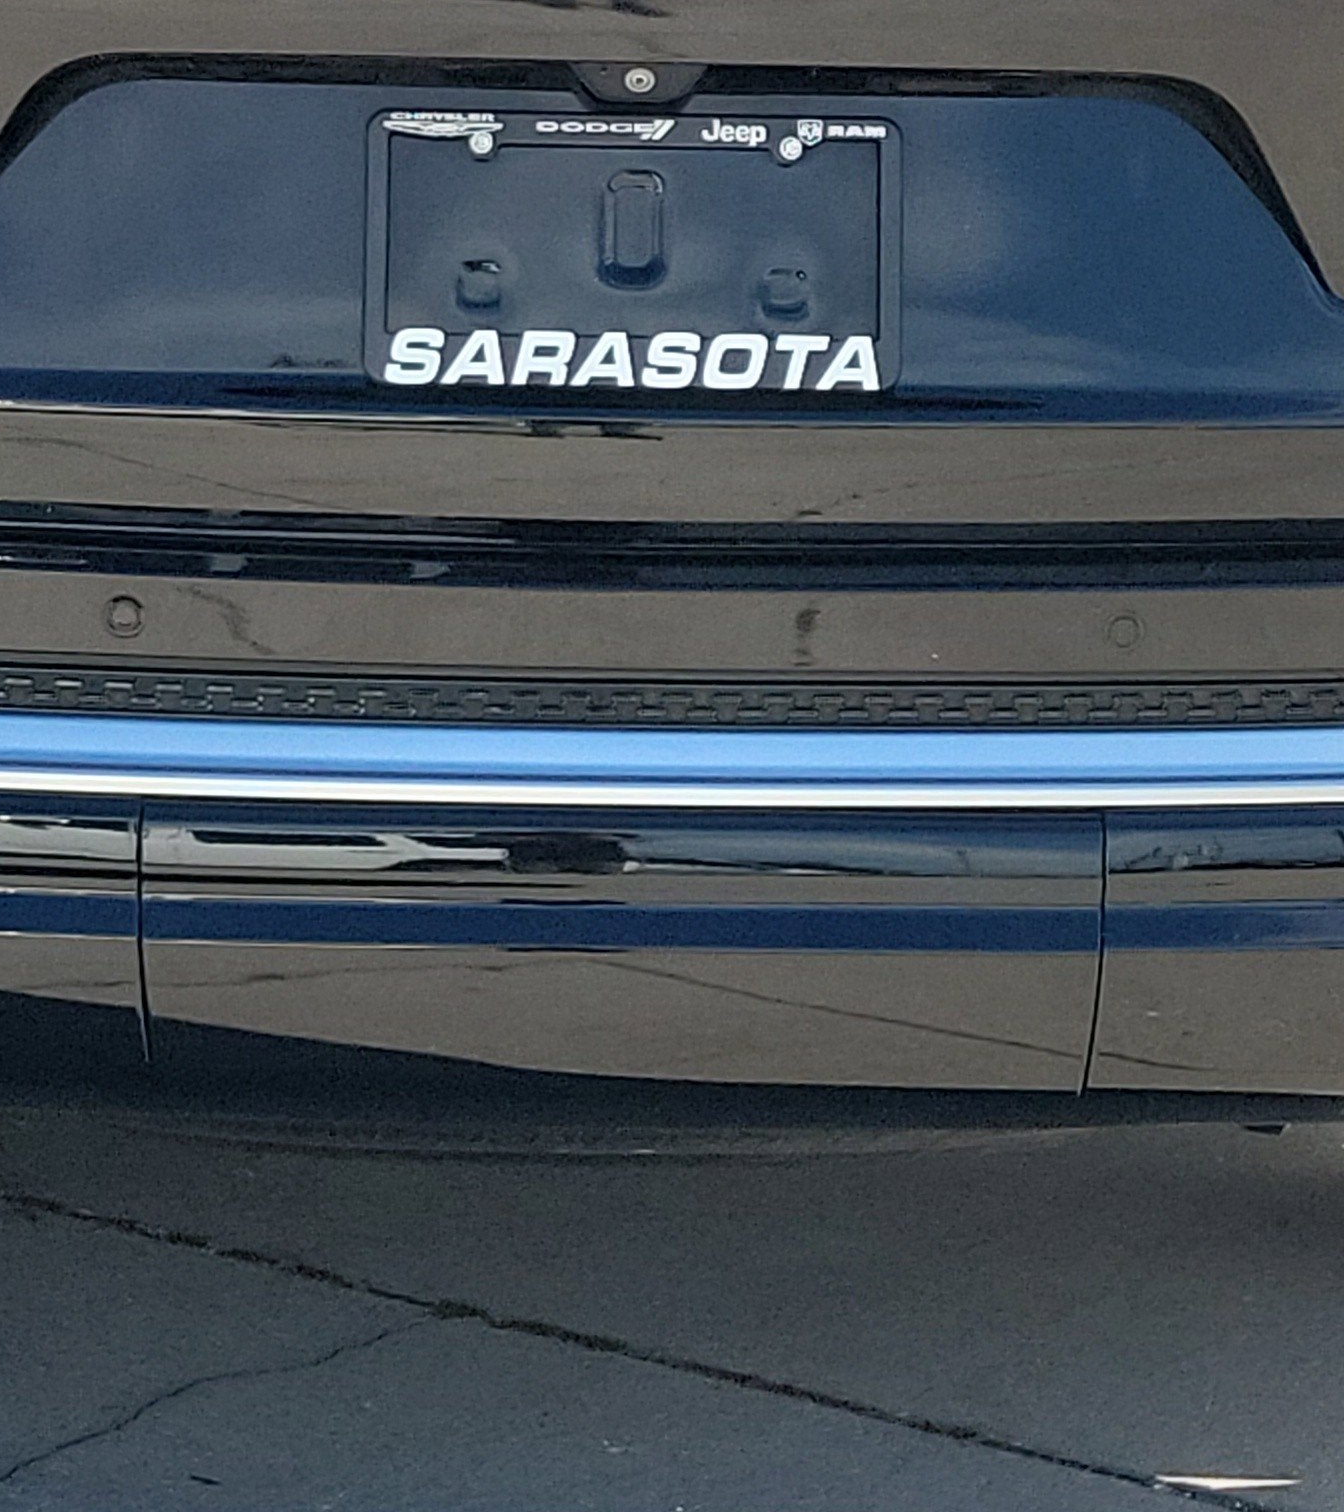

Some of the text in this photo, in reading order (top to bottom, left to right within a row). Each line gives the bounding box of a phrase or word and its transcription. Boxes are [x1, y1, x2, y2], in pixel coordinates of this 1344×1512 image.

[389, 112, 887, 147] CHRYSLER DODGE Jeep RAM
[382, 327, 882, 390] SARASOTA
